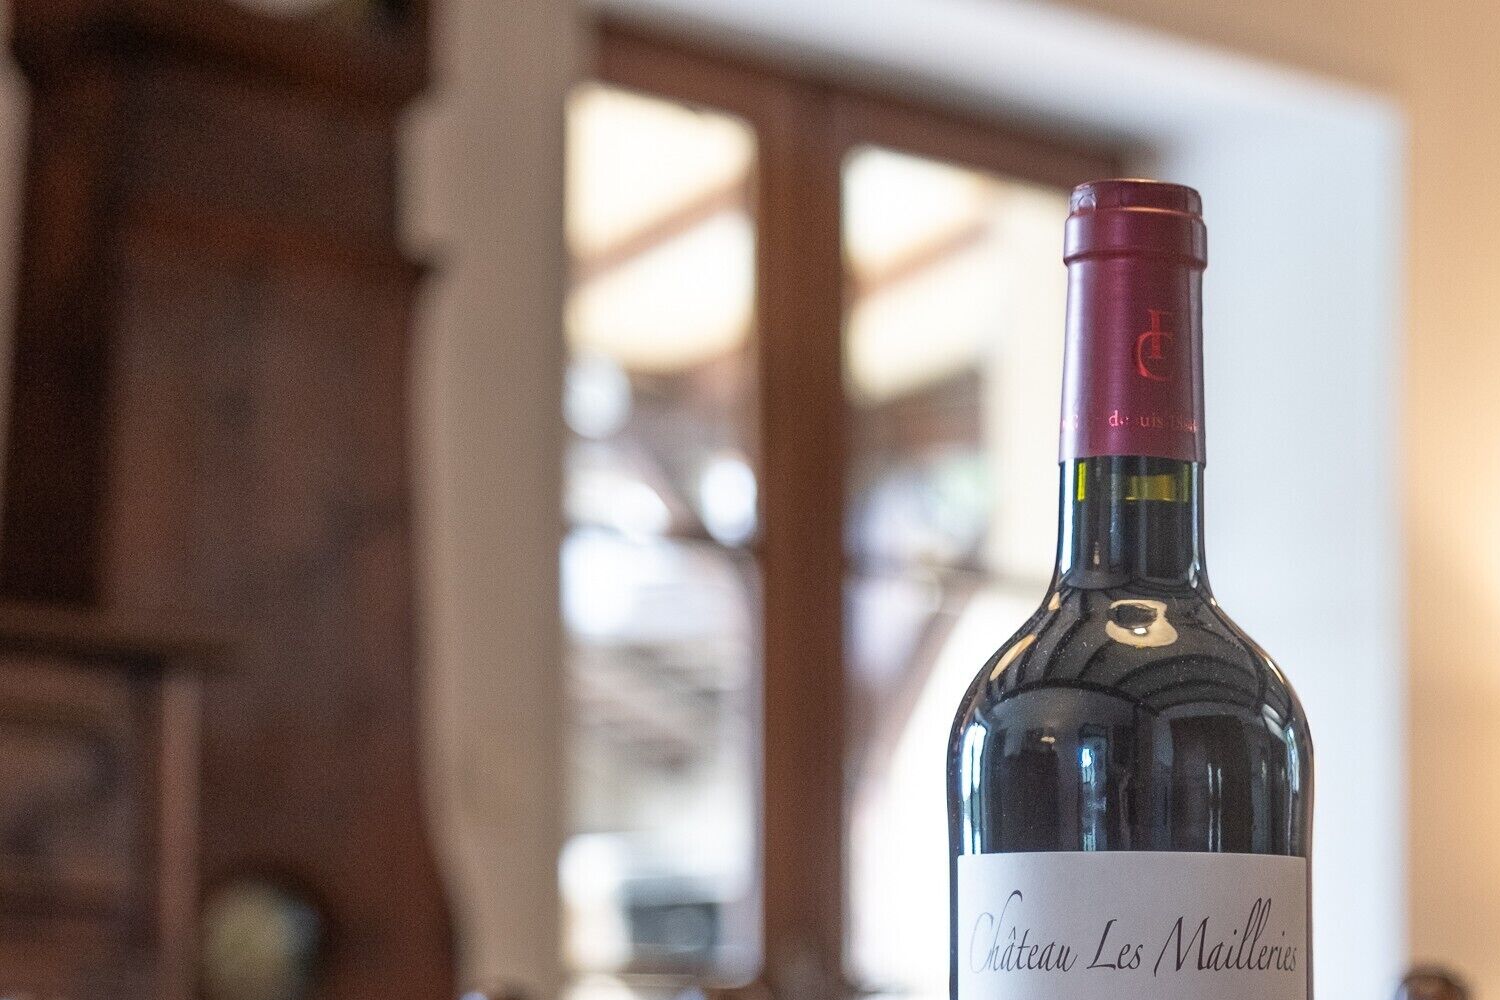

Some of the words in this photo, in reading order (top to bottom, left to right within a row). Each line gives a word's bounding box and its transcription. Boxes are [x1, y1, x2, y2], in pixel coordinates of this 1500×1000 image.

[970, 890, 1078, 974] Château
[1086, 919, 1143, 970] Les
[1153, 898, 1297, 977] Mailleries
